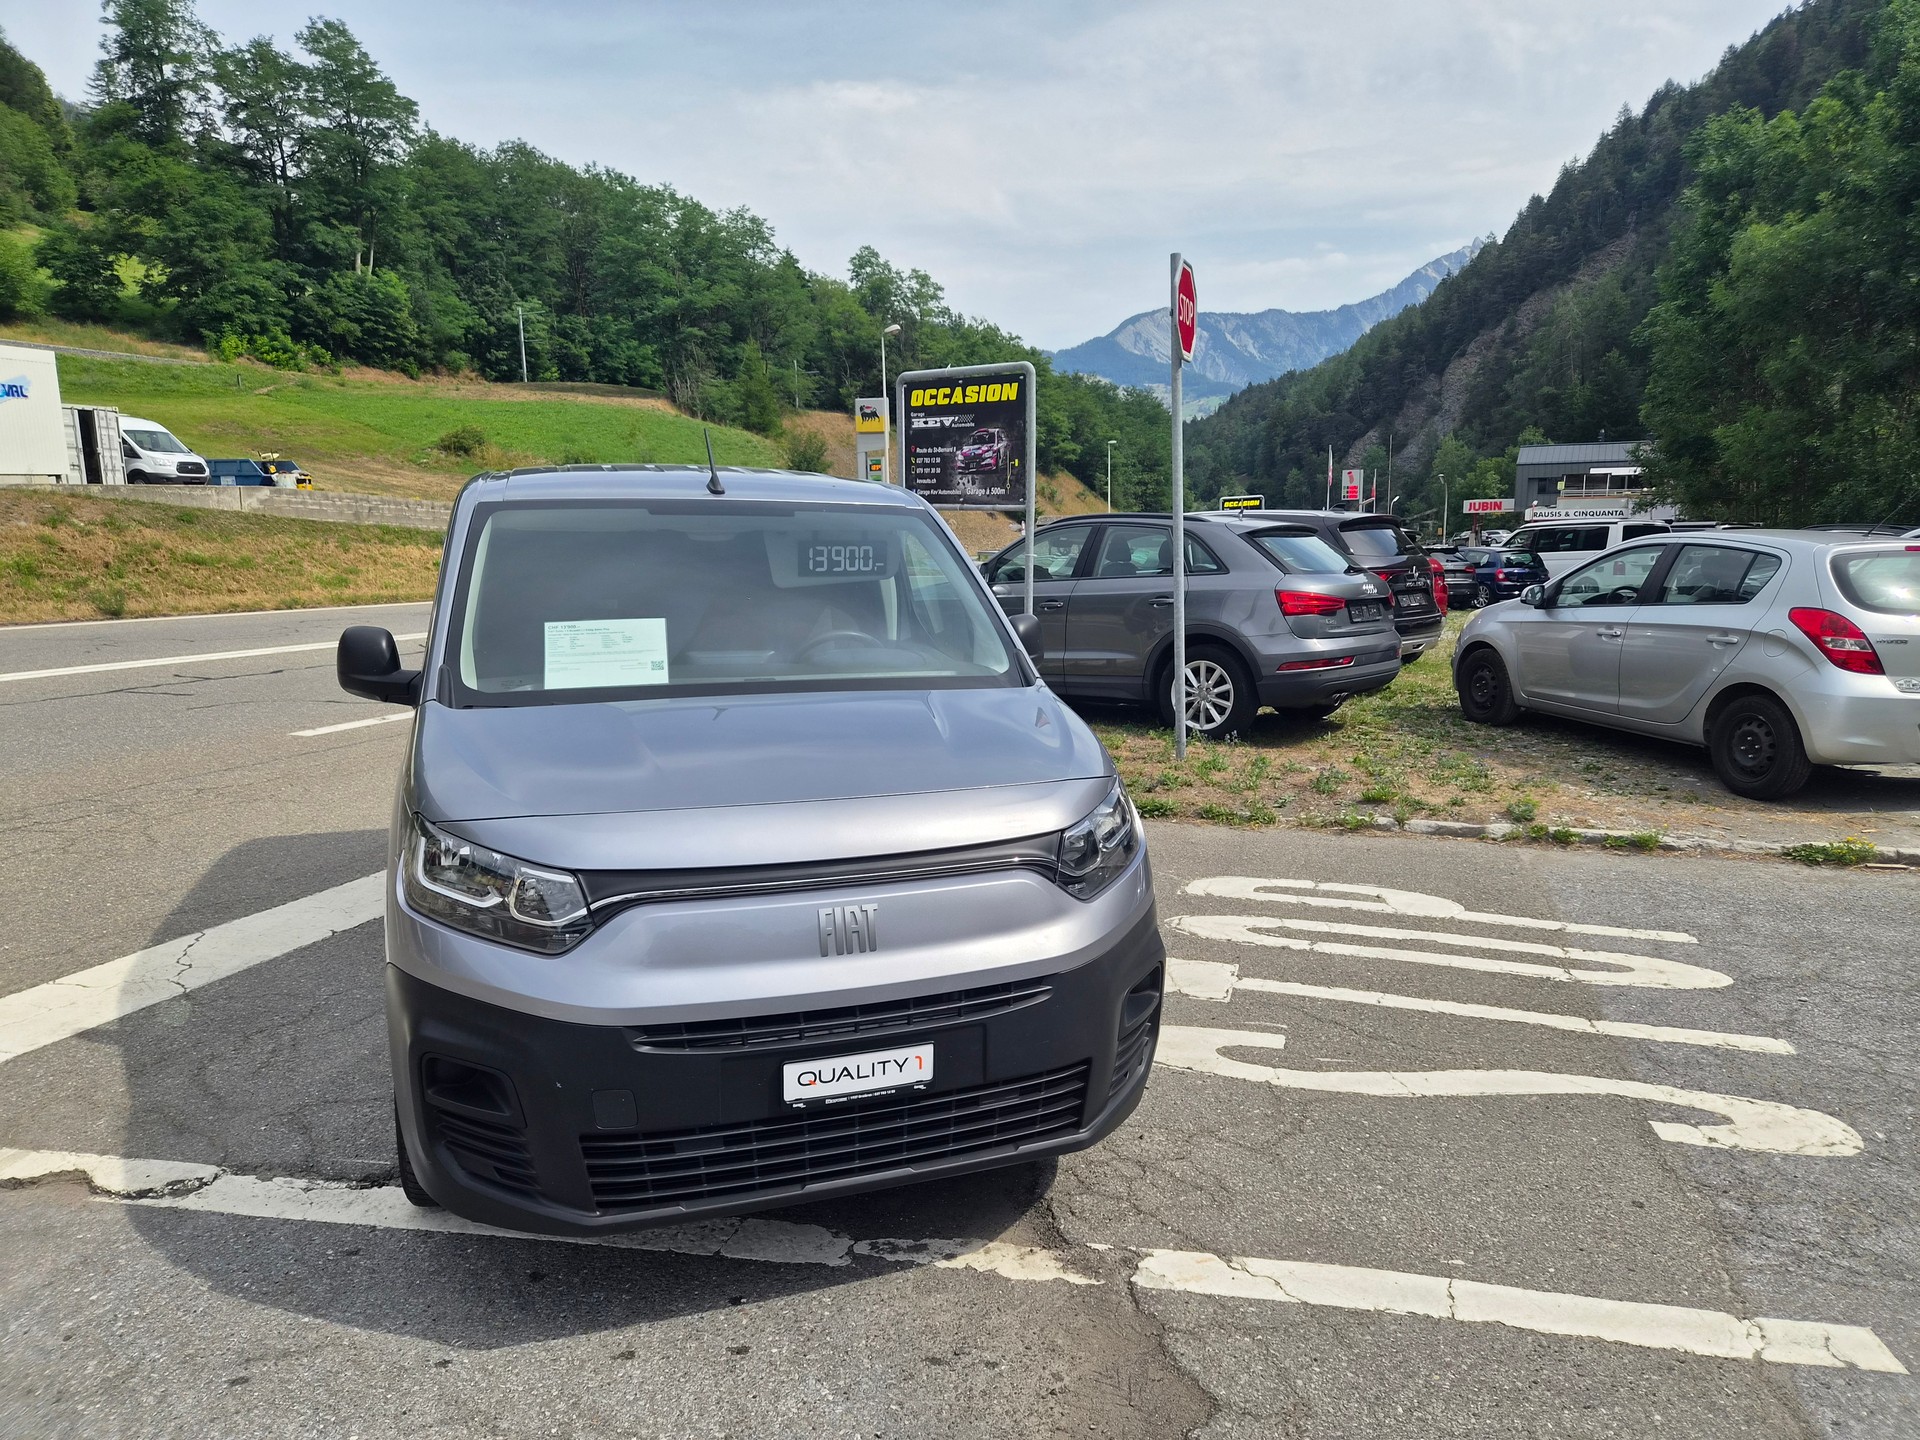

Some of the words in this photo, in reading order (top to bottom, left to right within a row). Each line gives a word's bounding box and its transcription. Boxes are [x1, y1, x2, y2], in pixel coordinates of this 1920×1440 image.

[1179, 293, 1194, 328] STOP
[910, 382, 1019, 407] OCCASION
[966, 488, 985, 496] Garage
[1223, 499, 1260, 508] OCCASION
[1468, 501, 1503, 512] JUBIN
[1533, 510, 1562, 518] RAUSIS
[1573, 509, 1625, 518] CINQUANTA
[817, 903, 878, 958] FIAT
[797, 1056, 909, 1087] QUALITY
[914, 1055, 923, 1071] 1
